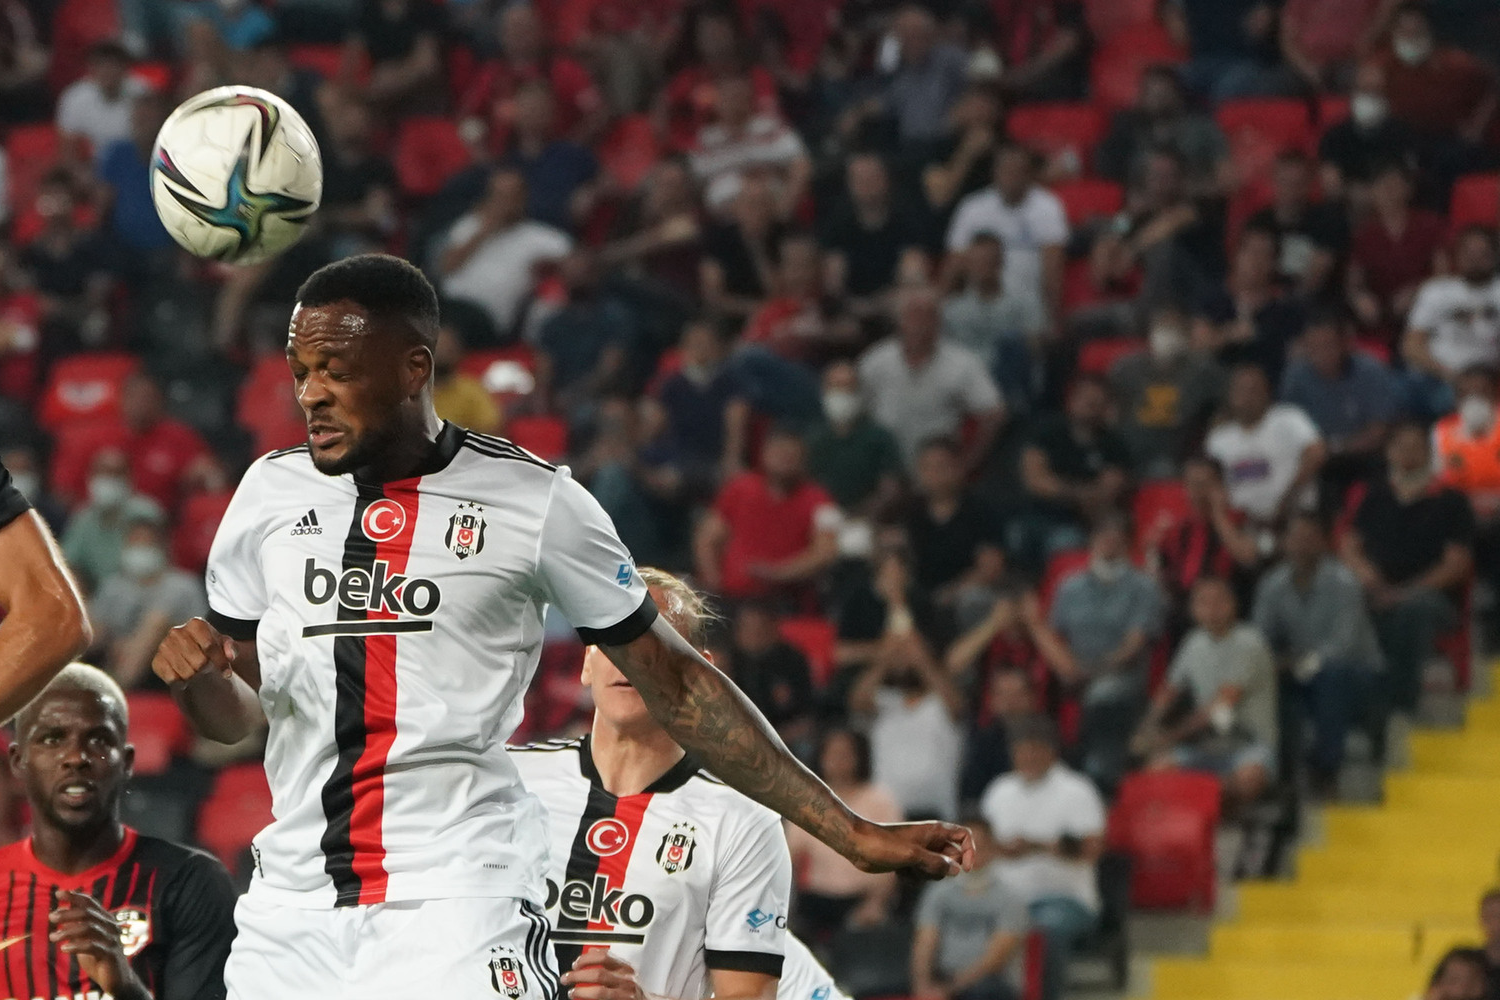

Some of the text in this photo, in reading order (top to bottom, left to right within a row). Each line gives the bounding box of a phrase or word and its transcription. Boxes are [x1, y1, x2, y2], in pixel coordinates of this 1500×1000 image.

[455, 515, 481, 529] BJK
[290, 526, 323, 536] adidas
[303, 558, 442, 618] beko
